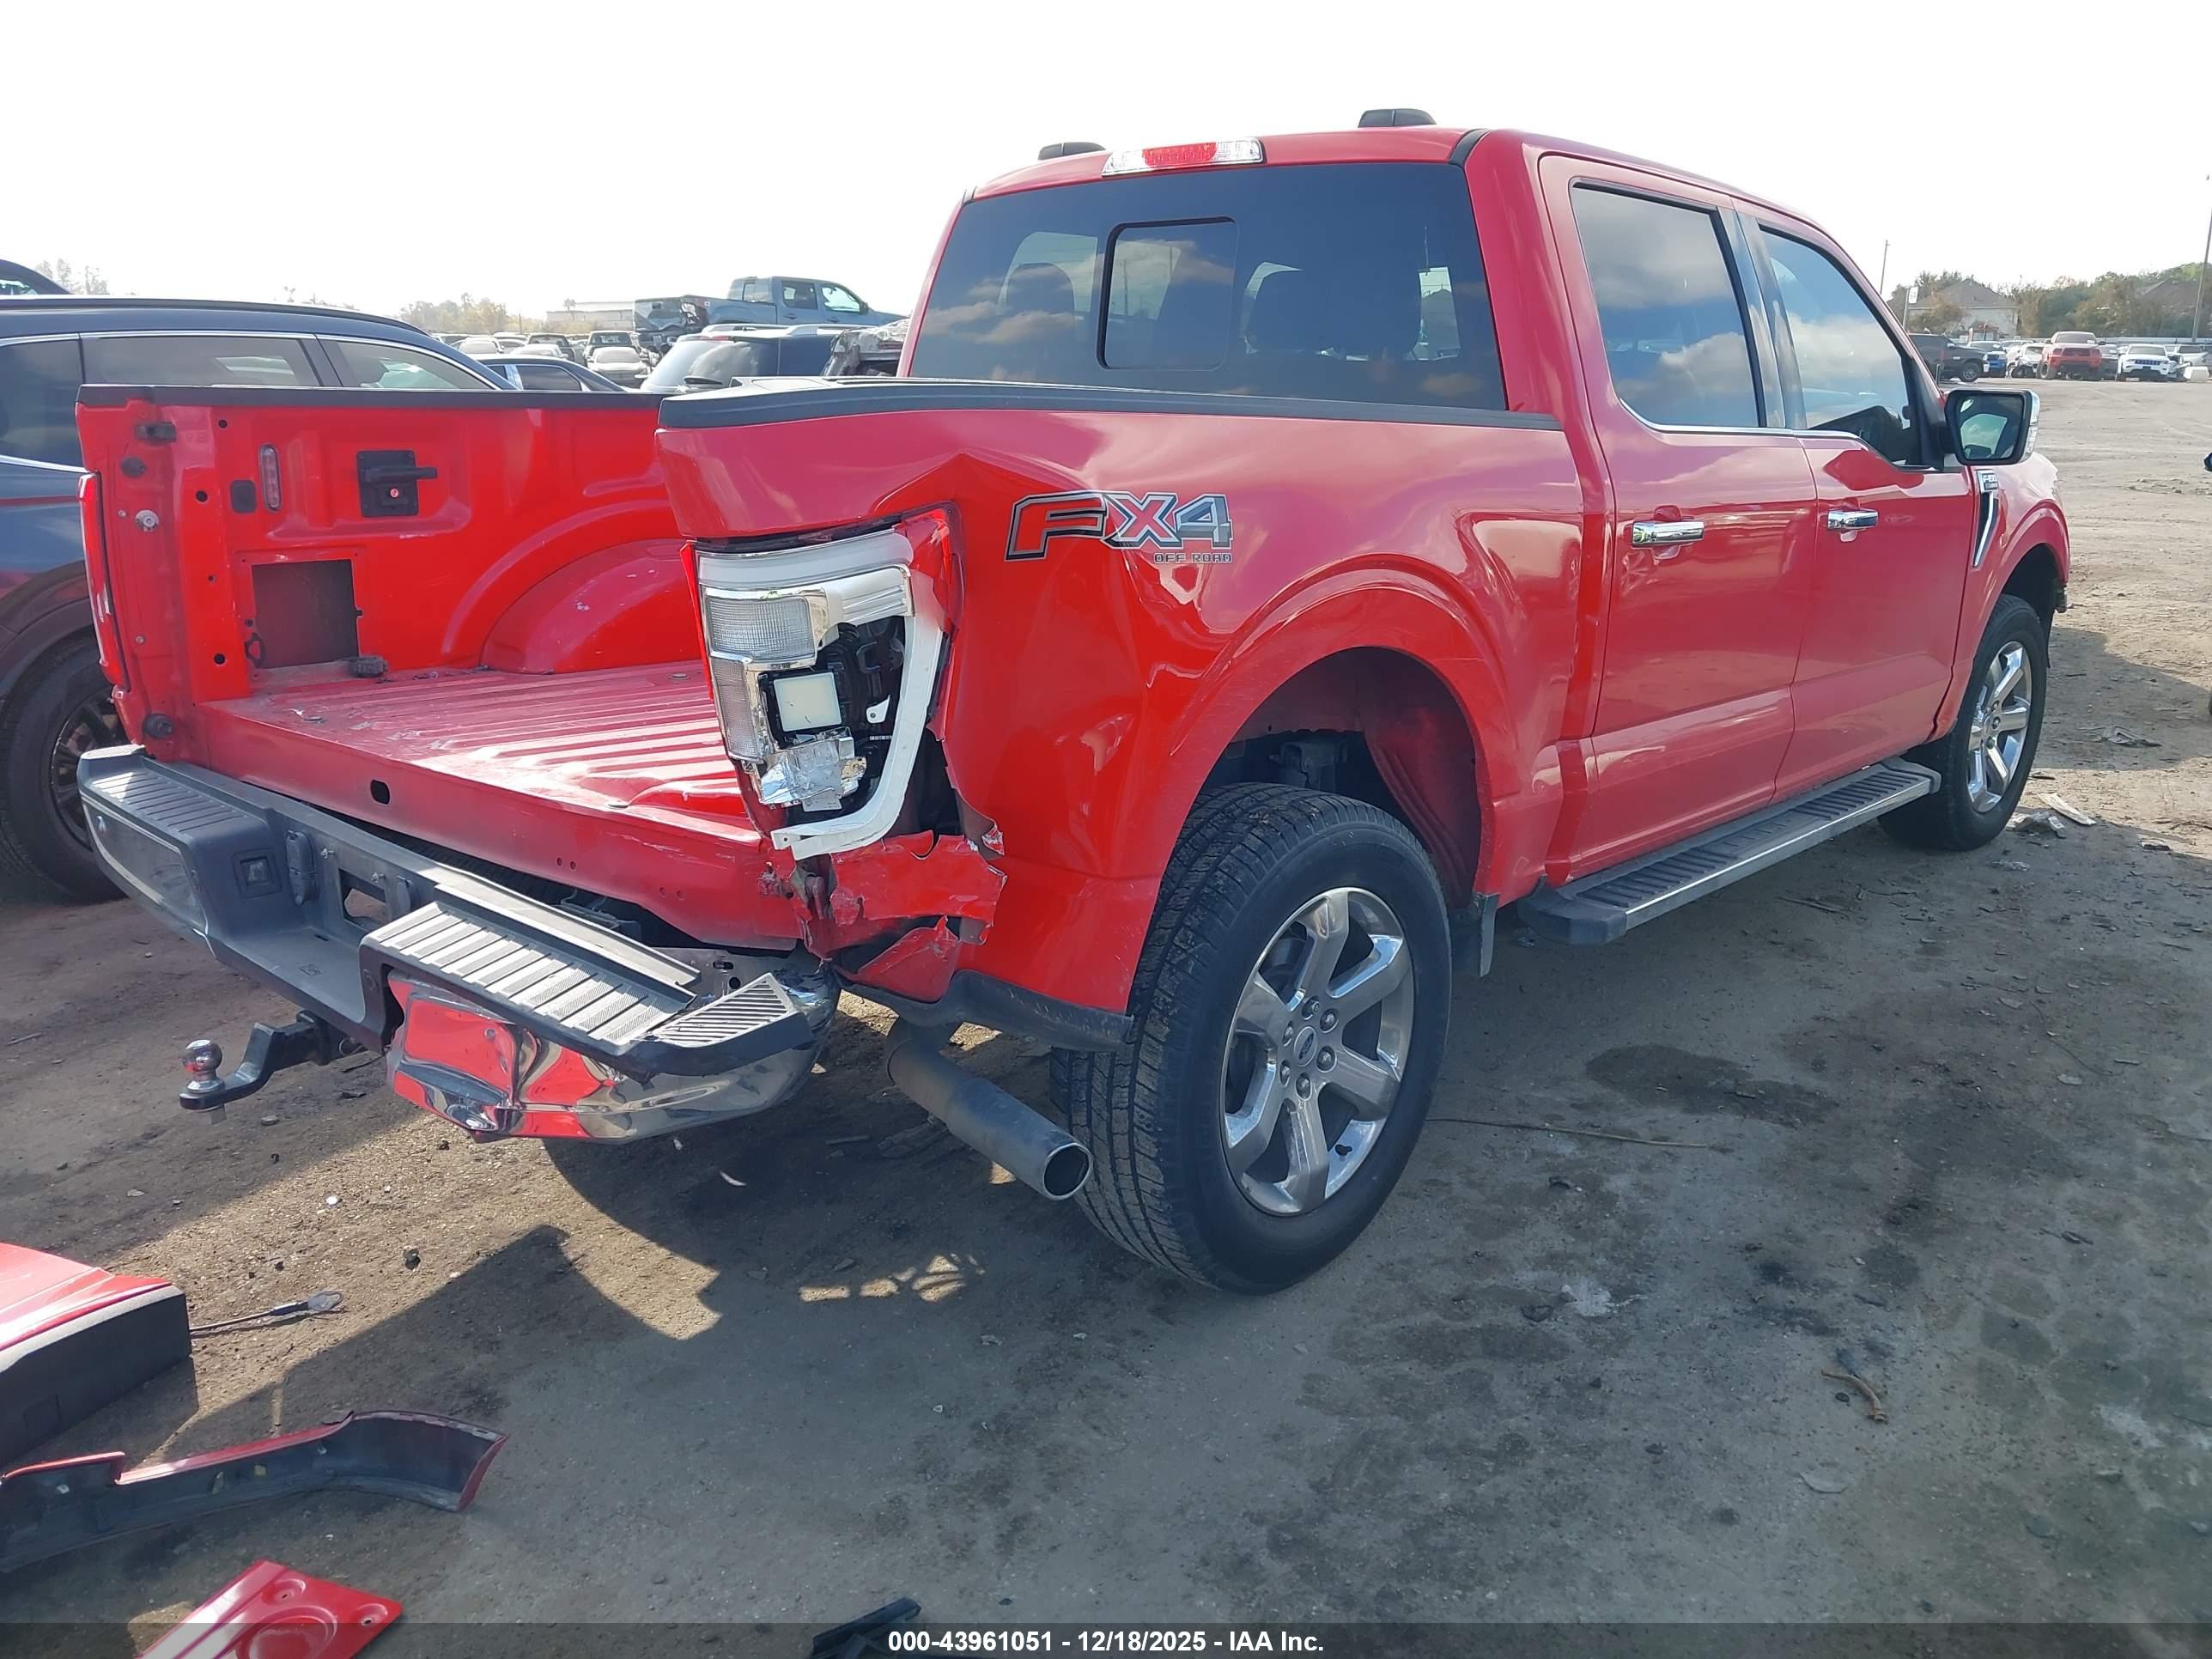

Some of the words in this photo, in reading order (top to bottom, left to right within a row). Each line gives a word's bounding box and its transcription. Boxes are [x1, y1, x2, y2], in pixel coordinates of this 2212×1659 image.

[1004, 489, 1233, 562] FX4
[1154, 552, 1186, 563] OFF
[1191, 552, 1232, 563] ROAD
